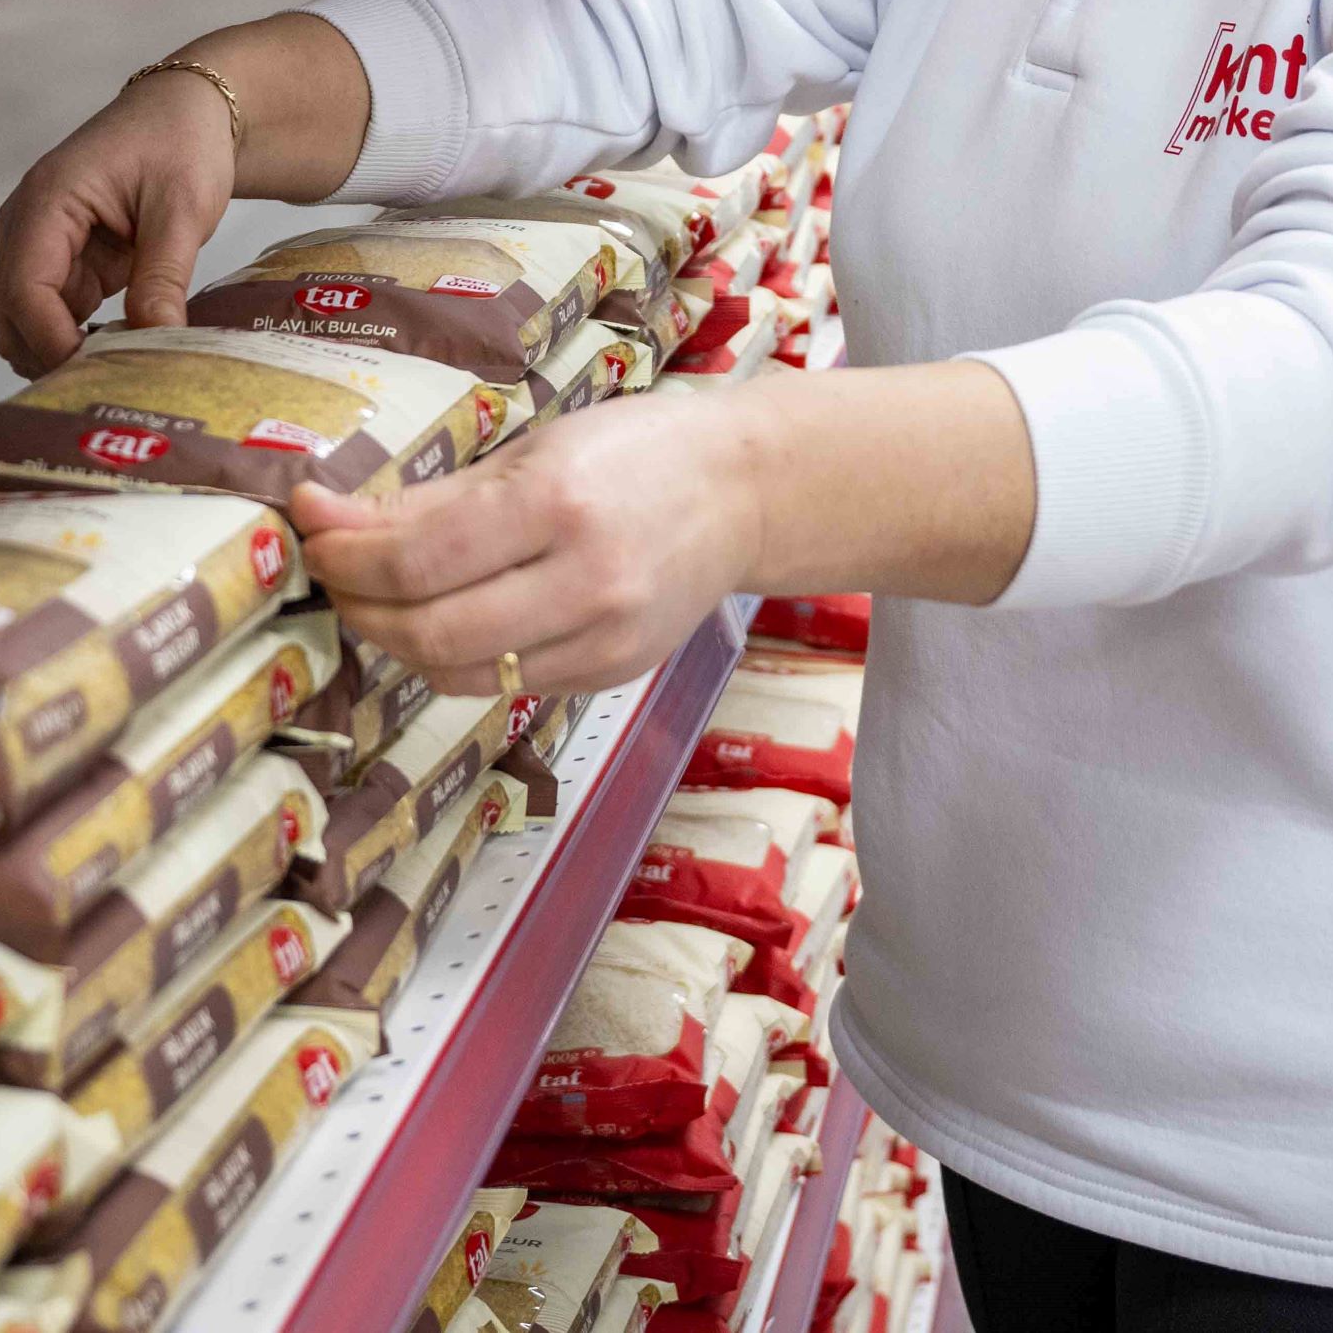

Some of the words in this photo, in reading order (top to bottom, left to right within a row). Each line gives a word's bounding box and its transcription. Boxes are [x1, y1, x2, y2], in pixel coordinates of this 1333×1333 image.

[303, 286, 364, 310] tat
[253, 315, 326, 334] PİLAVLIK
[327, 320, 398, 338] BULGUR
[87, 428, 160, 461] tat
[538, 1068, 582, 1088] tat
[469, 1235, 490, 1287] tat
